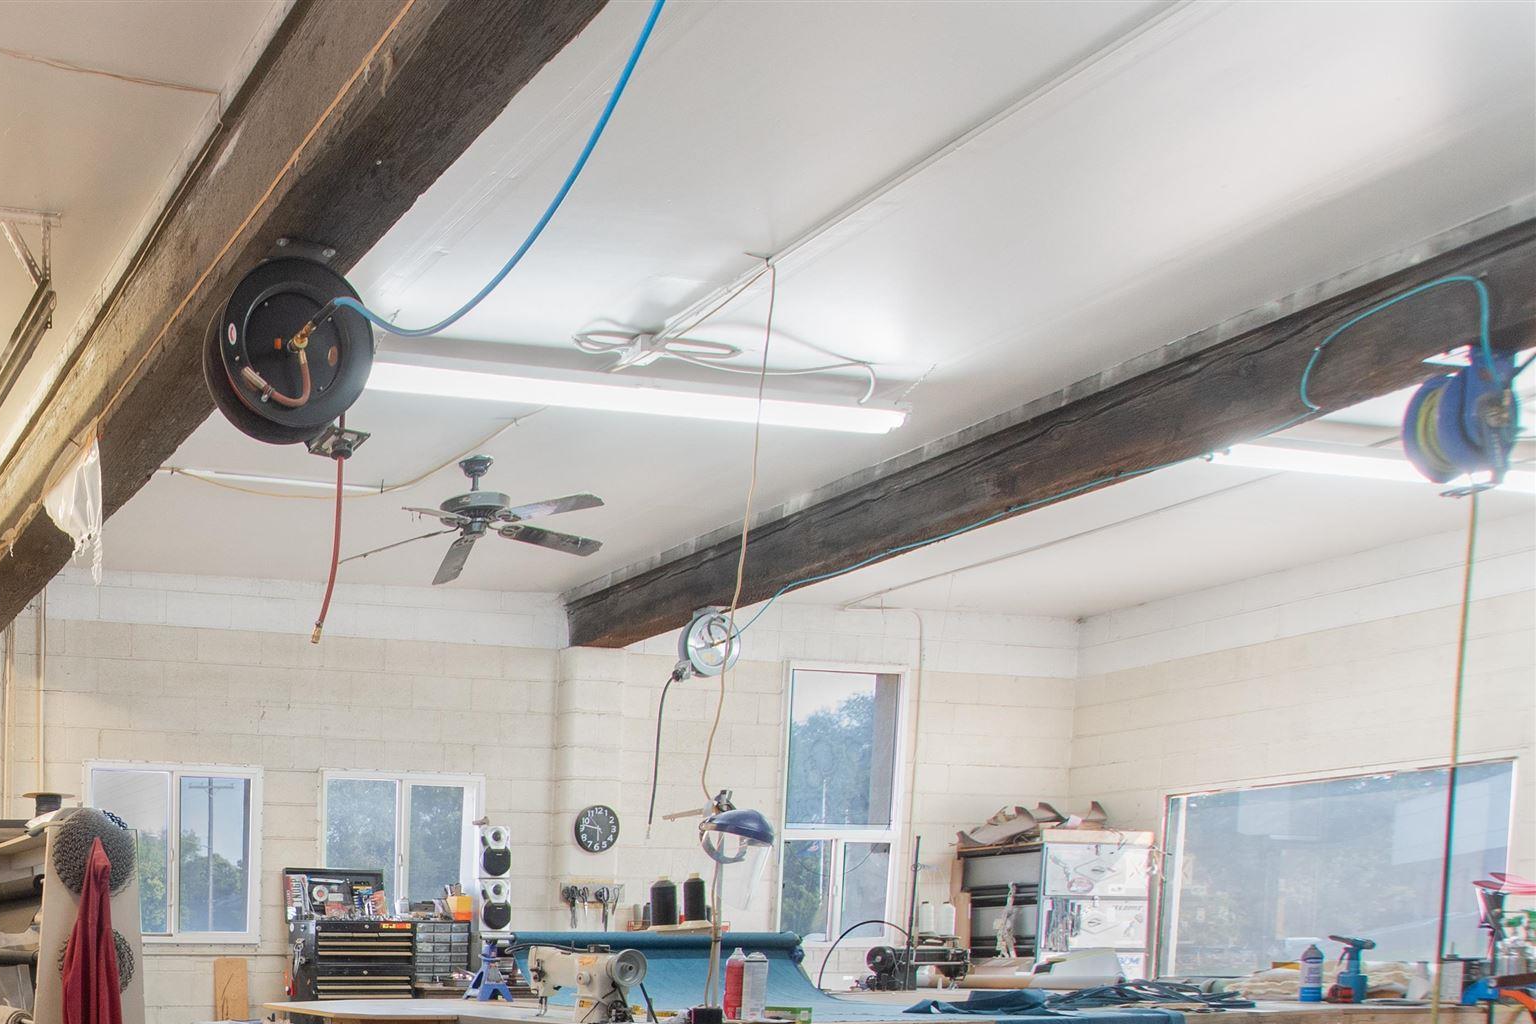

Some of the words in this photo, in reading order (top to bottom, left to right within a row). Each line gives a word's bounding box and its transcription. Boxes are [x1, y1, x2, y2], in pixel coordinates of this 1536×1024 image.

[595, 807, 603, 815] 12
[582, 816, 590, 824] 10
[609, 816, 614, 824] 2
[611, 825, 616, 833] 3
[581, 833, 587, 842] 8
[607, 834, 613, 842] 4
[587, 840, 593, 848] 7
[594, 843, 600, 851] 6
